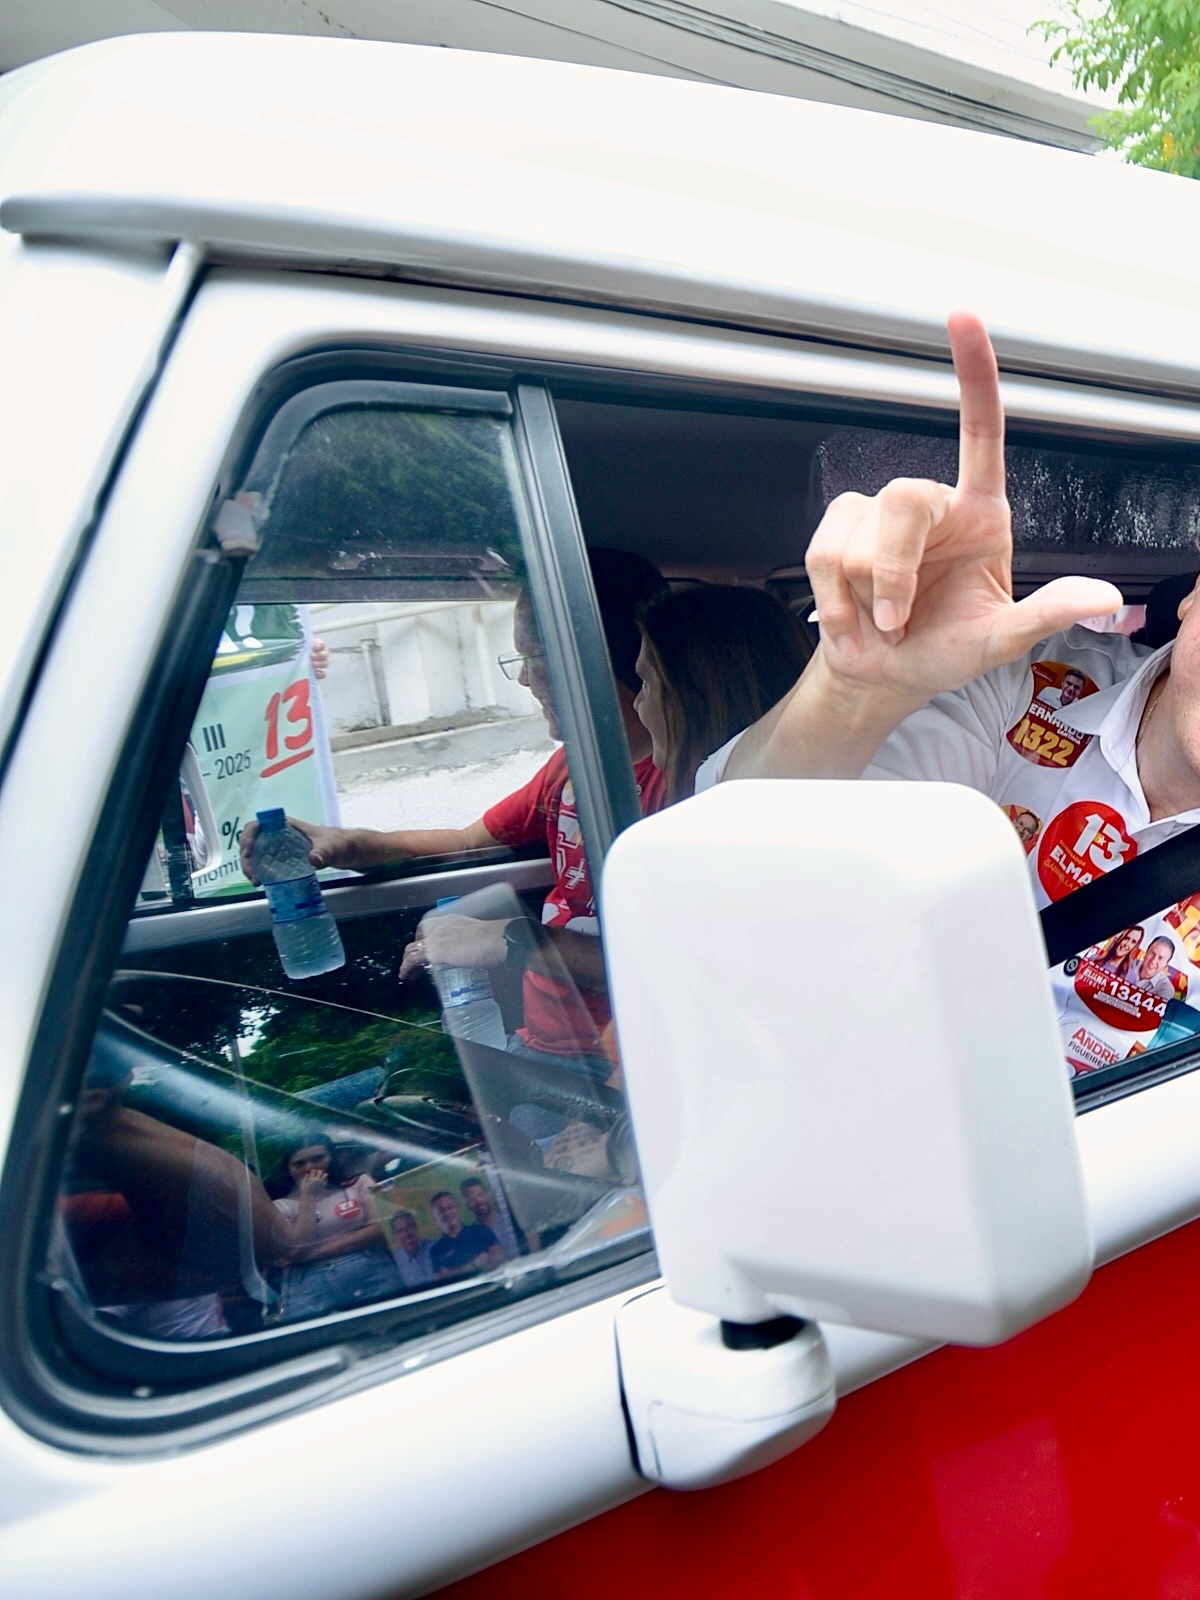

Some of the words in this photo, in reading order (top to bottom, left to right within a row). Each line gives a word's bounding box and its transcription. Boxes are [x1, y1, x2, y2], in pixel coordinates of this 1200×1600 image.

[264, 678, 313, 760] 13
[1028, 703, 1085, 740] ERNANDO
[1013, 719, 1068, 767] 1322
[214, 749, 251, 780] 2025
[1072, 813, 1130, 873] 13
[198, 855, 240, 887] nomi
[1049, 844, 1093, 886] ELMA
[1109, 980, 1168, 1018] 13444
[1071, 1026, 1120, 1064] ANDRÉ
